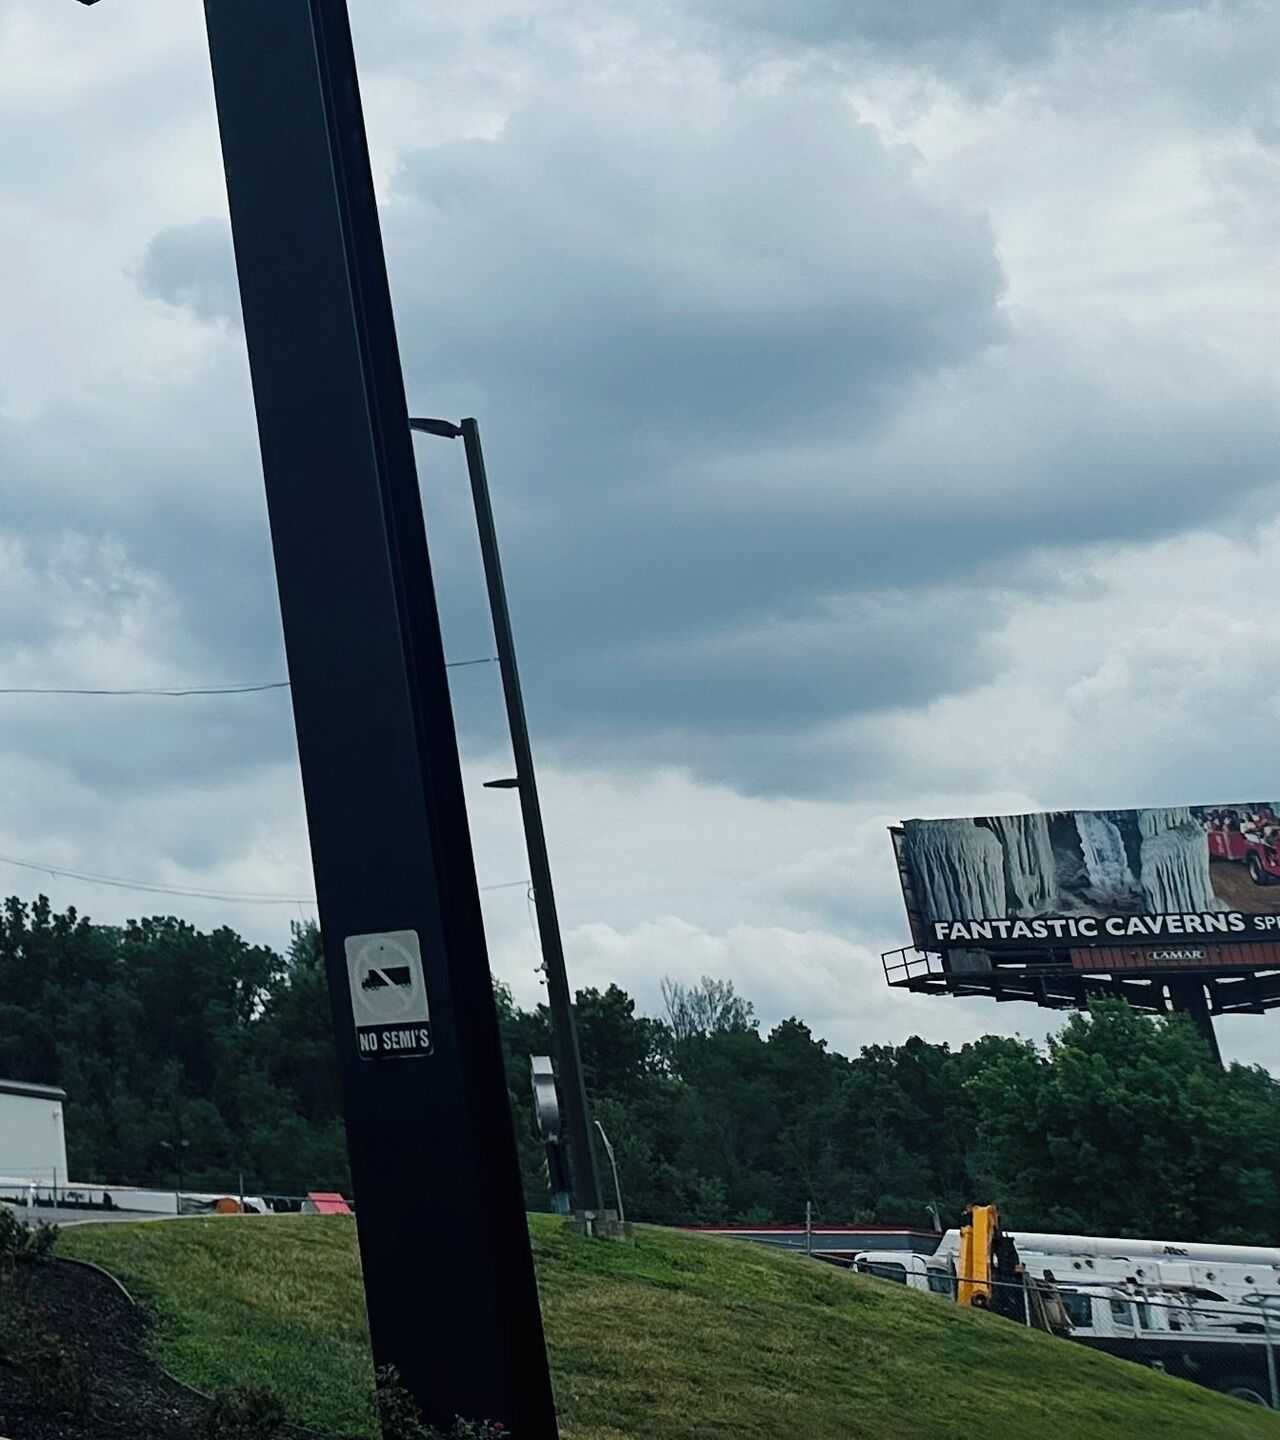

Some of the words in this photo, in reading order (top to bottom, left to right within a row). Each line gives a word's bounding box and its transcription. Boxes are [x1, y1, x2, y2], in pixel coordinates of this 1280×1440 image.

[934, 918, 1099, 940] FANTASTIC
[1106, 913, 1246, 937] CAVERNS
[1153, 950, 1202, 959] LAMAR
[359, 1032, 378, 1052] NO
[383, 1029, 430, 1049] SEMI'S
